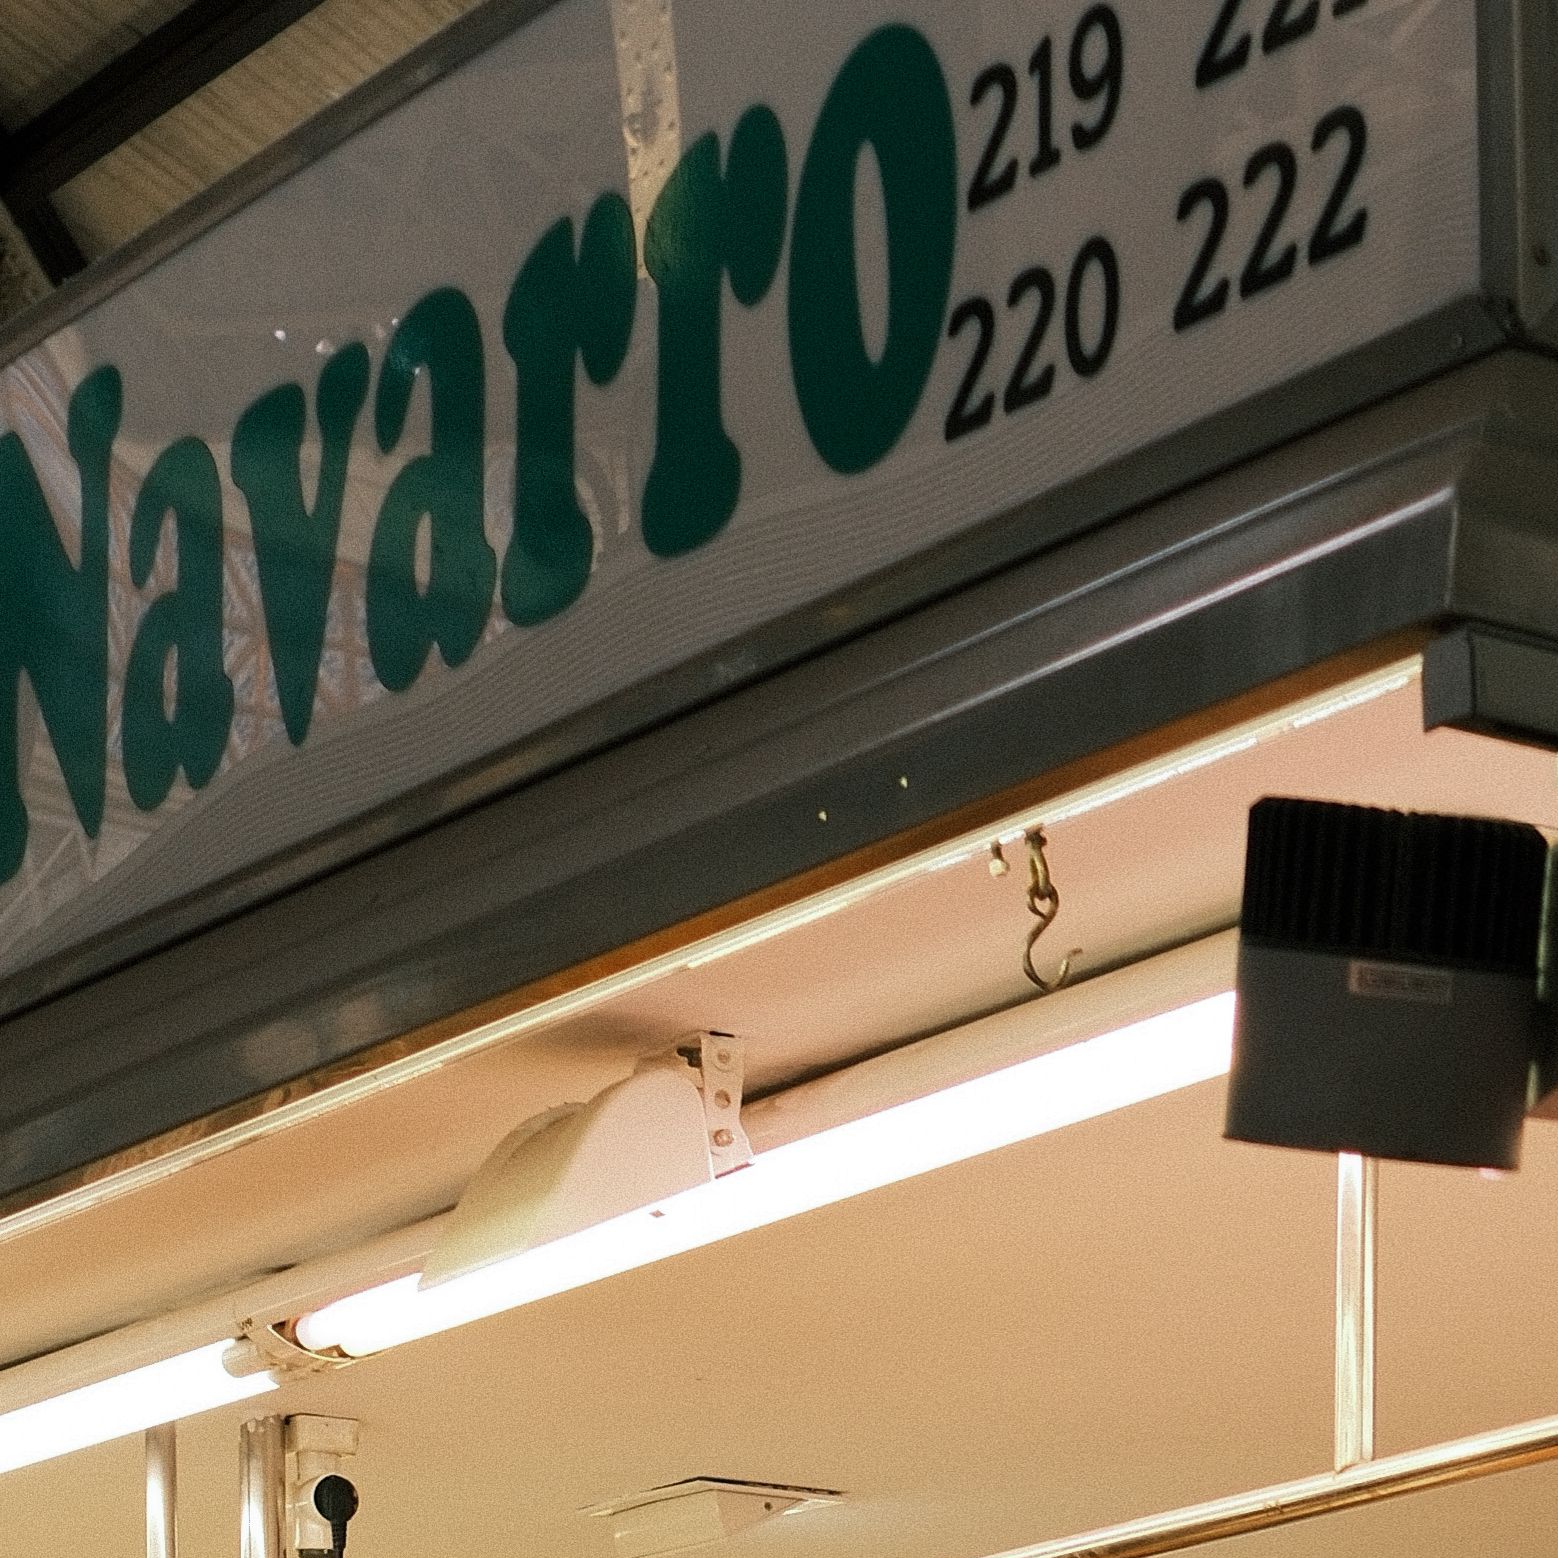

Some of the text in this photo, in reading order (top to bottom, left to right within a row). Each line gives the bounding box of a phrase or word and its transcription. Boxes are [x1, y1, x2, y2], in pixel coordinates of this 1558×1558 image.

[944, 105, 1368, 442] 220 222
[967, 4, 1123, 213] 219
[0, 20, 958, 885] Navarro
